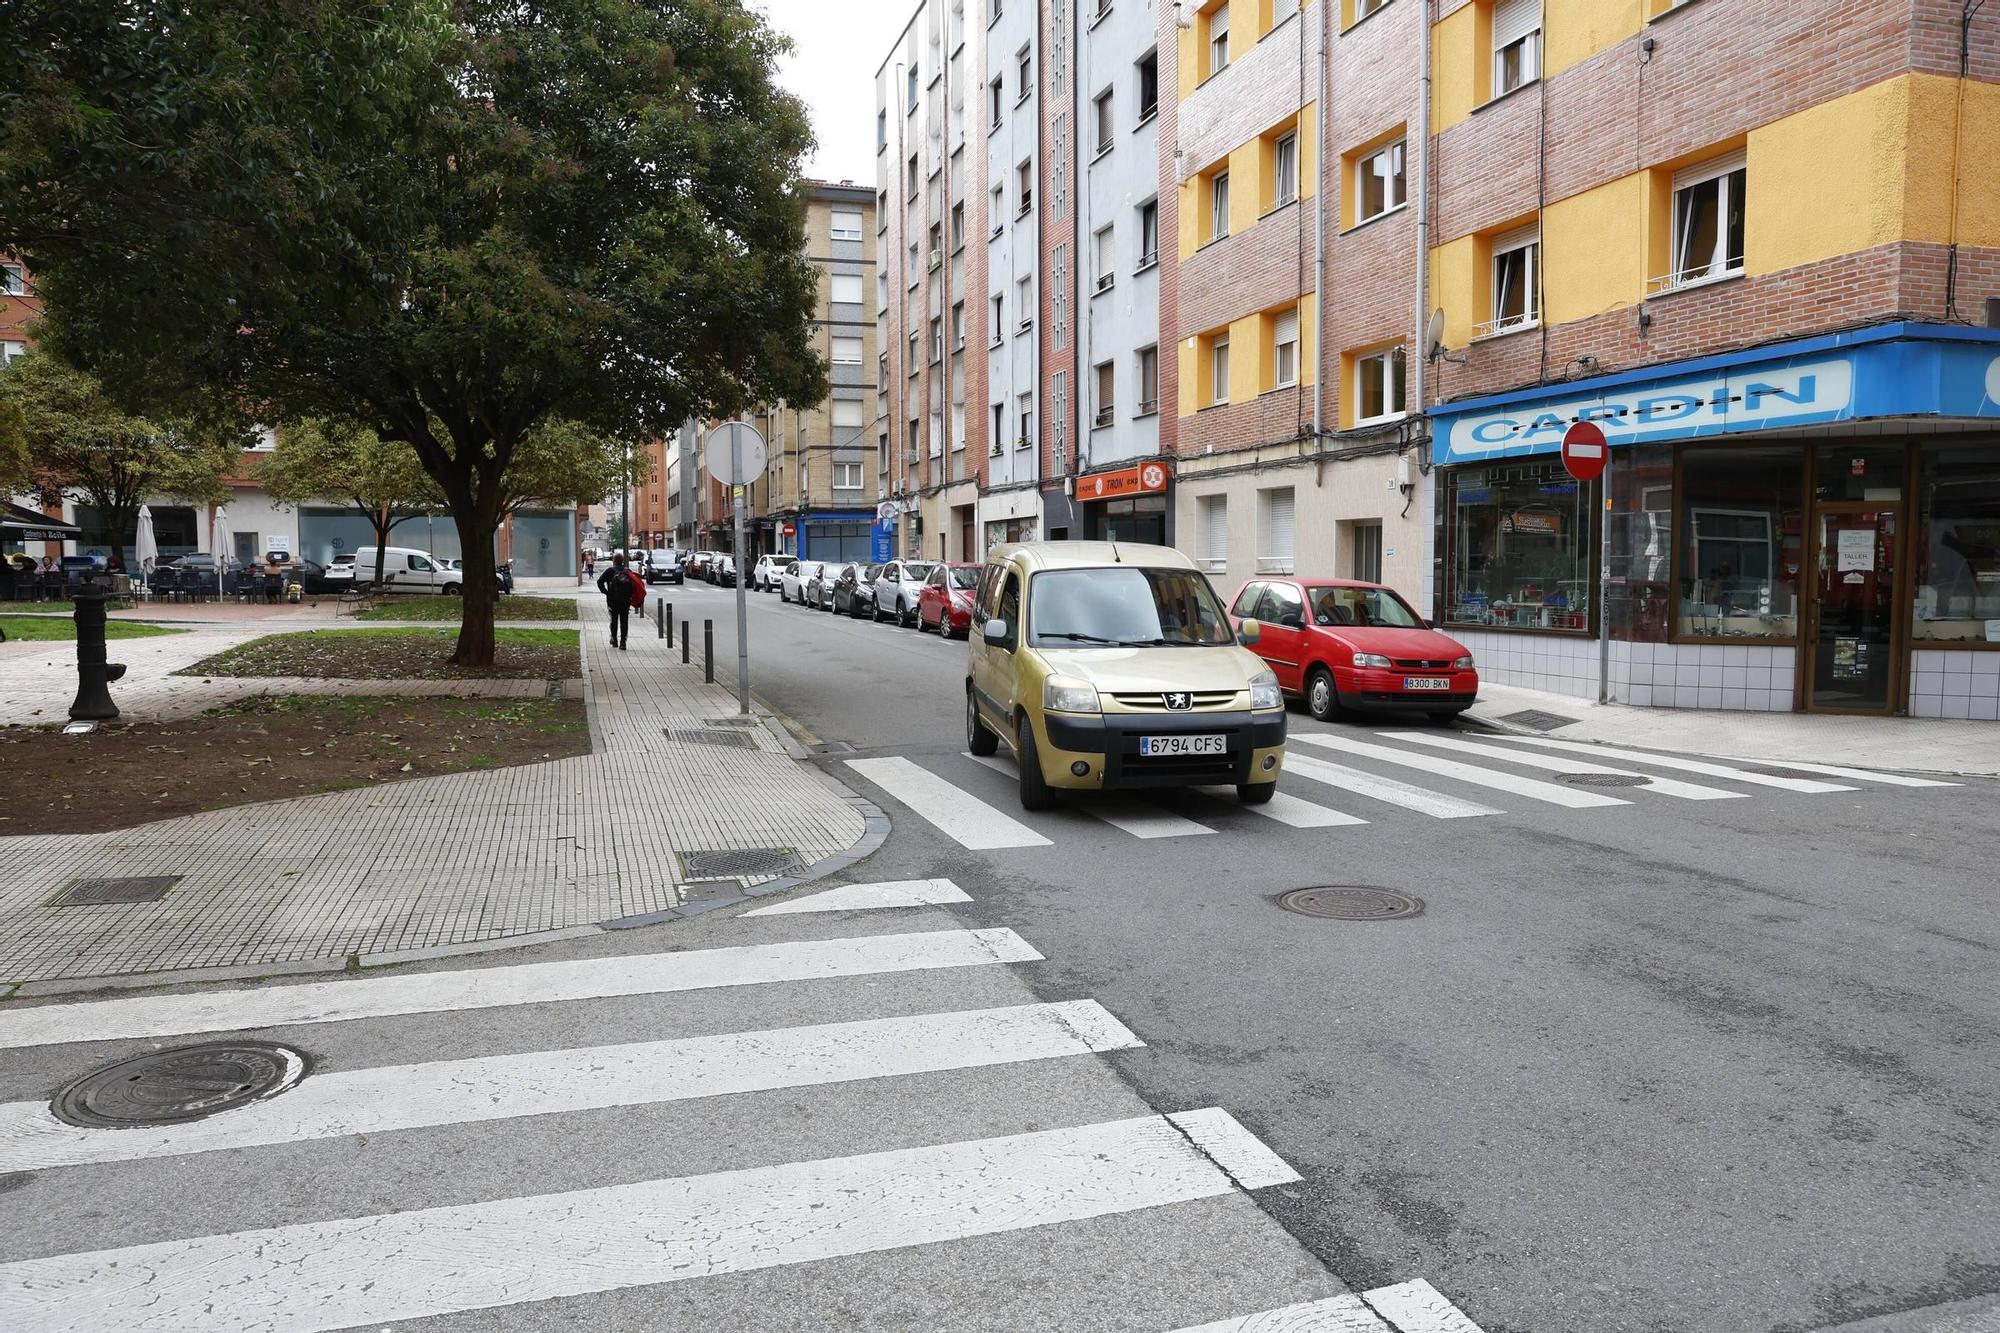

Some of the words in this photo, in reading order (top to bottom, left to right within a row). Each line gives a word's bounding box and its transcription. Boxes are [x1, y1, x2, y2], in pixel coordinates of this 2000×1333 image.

[1472, 375, 1816, 443] CARDIN
[1106, 478, 1124, 490] TRON
[1409, 679, 1430, 688] 8300
[1433, 679, 1448, 688] BKN
[1151, 738, 1189, 753] 6794
[1194, 737, 1223, 752] CFS
